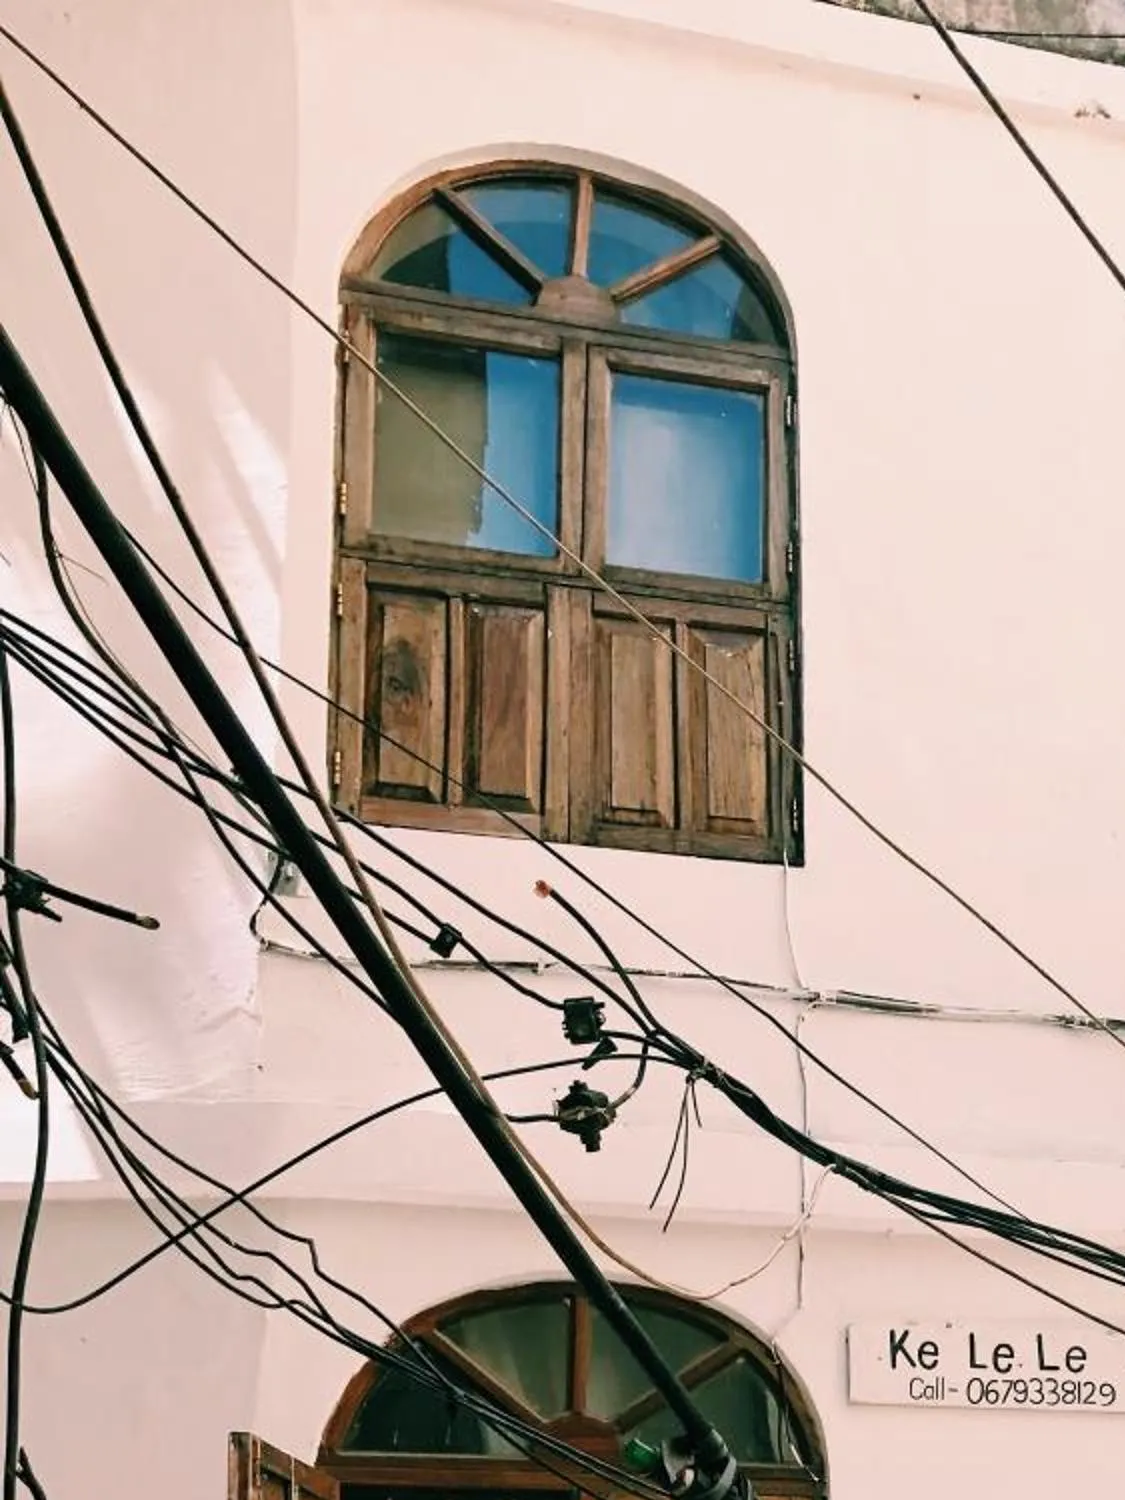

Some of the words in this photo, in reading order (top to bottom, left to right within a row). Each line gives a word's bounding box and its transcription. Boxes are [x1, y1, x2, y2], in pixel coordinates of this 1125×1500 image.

[888, 1329, 940, 1371] Ke
[968, 1332, 1015, 1374] Le
[1036, 1334, 1088, 1373] Le
[966, 1377, 1117, 1407] 0679338129
